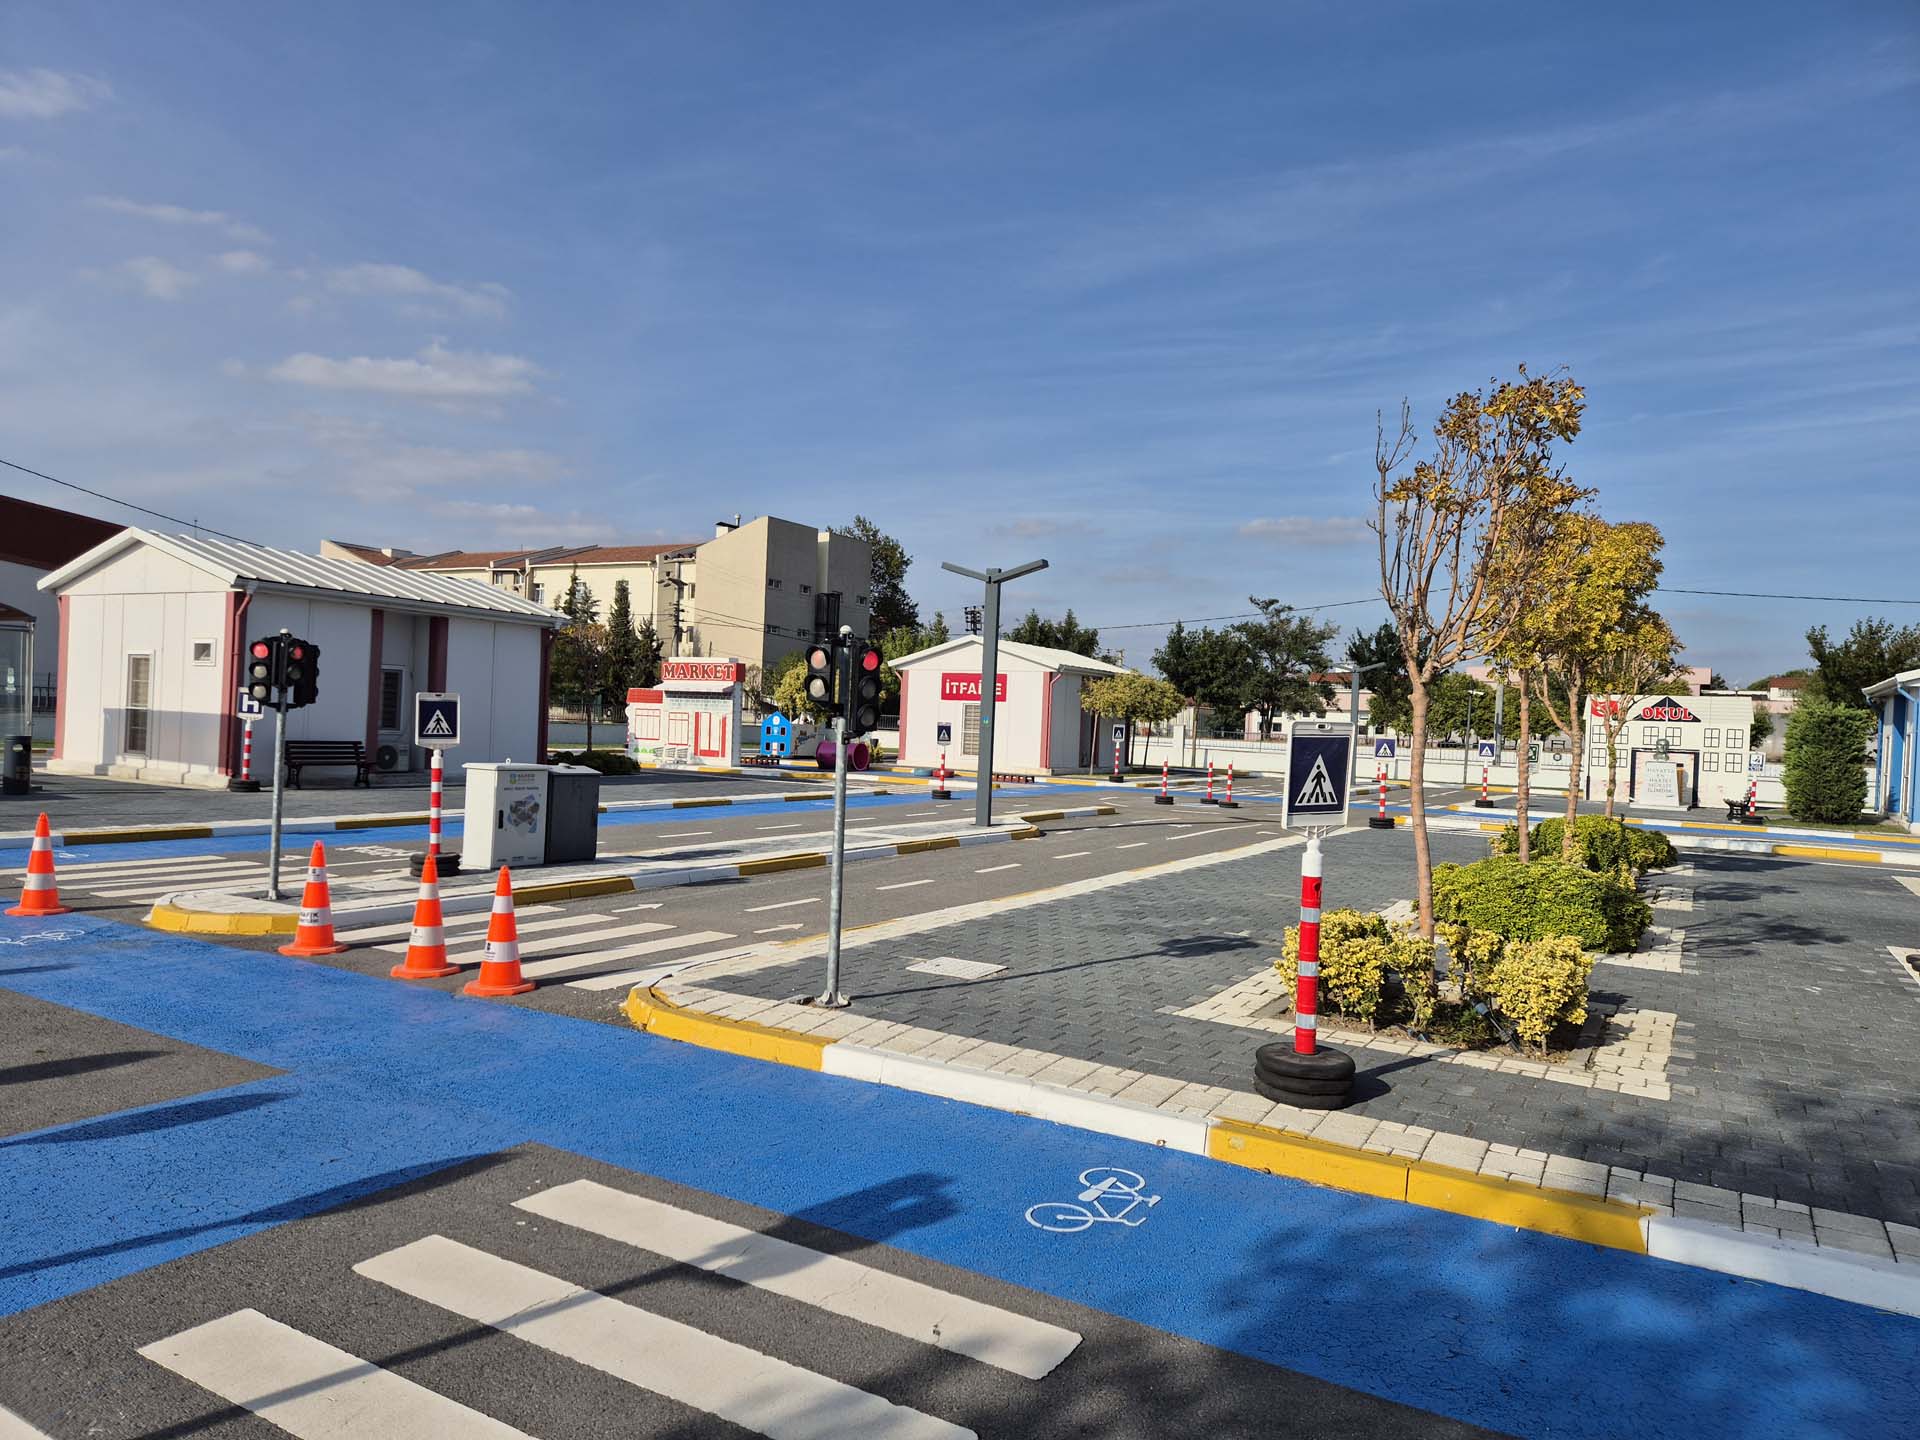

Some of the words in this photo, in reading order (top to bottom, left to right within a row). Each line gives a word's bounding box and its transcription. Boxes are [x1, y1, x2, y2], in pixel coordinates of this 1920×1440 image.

[663, 664, 734, 680] MARKET
[945, 679, 1002, 696] İTFAİE
[1642, 706, 1693, 721] OKUL
